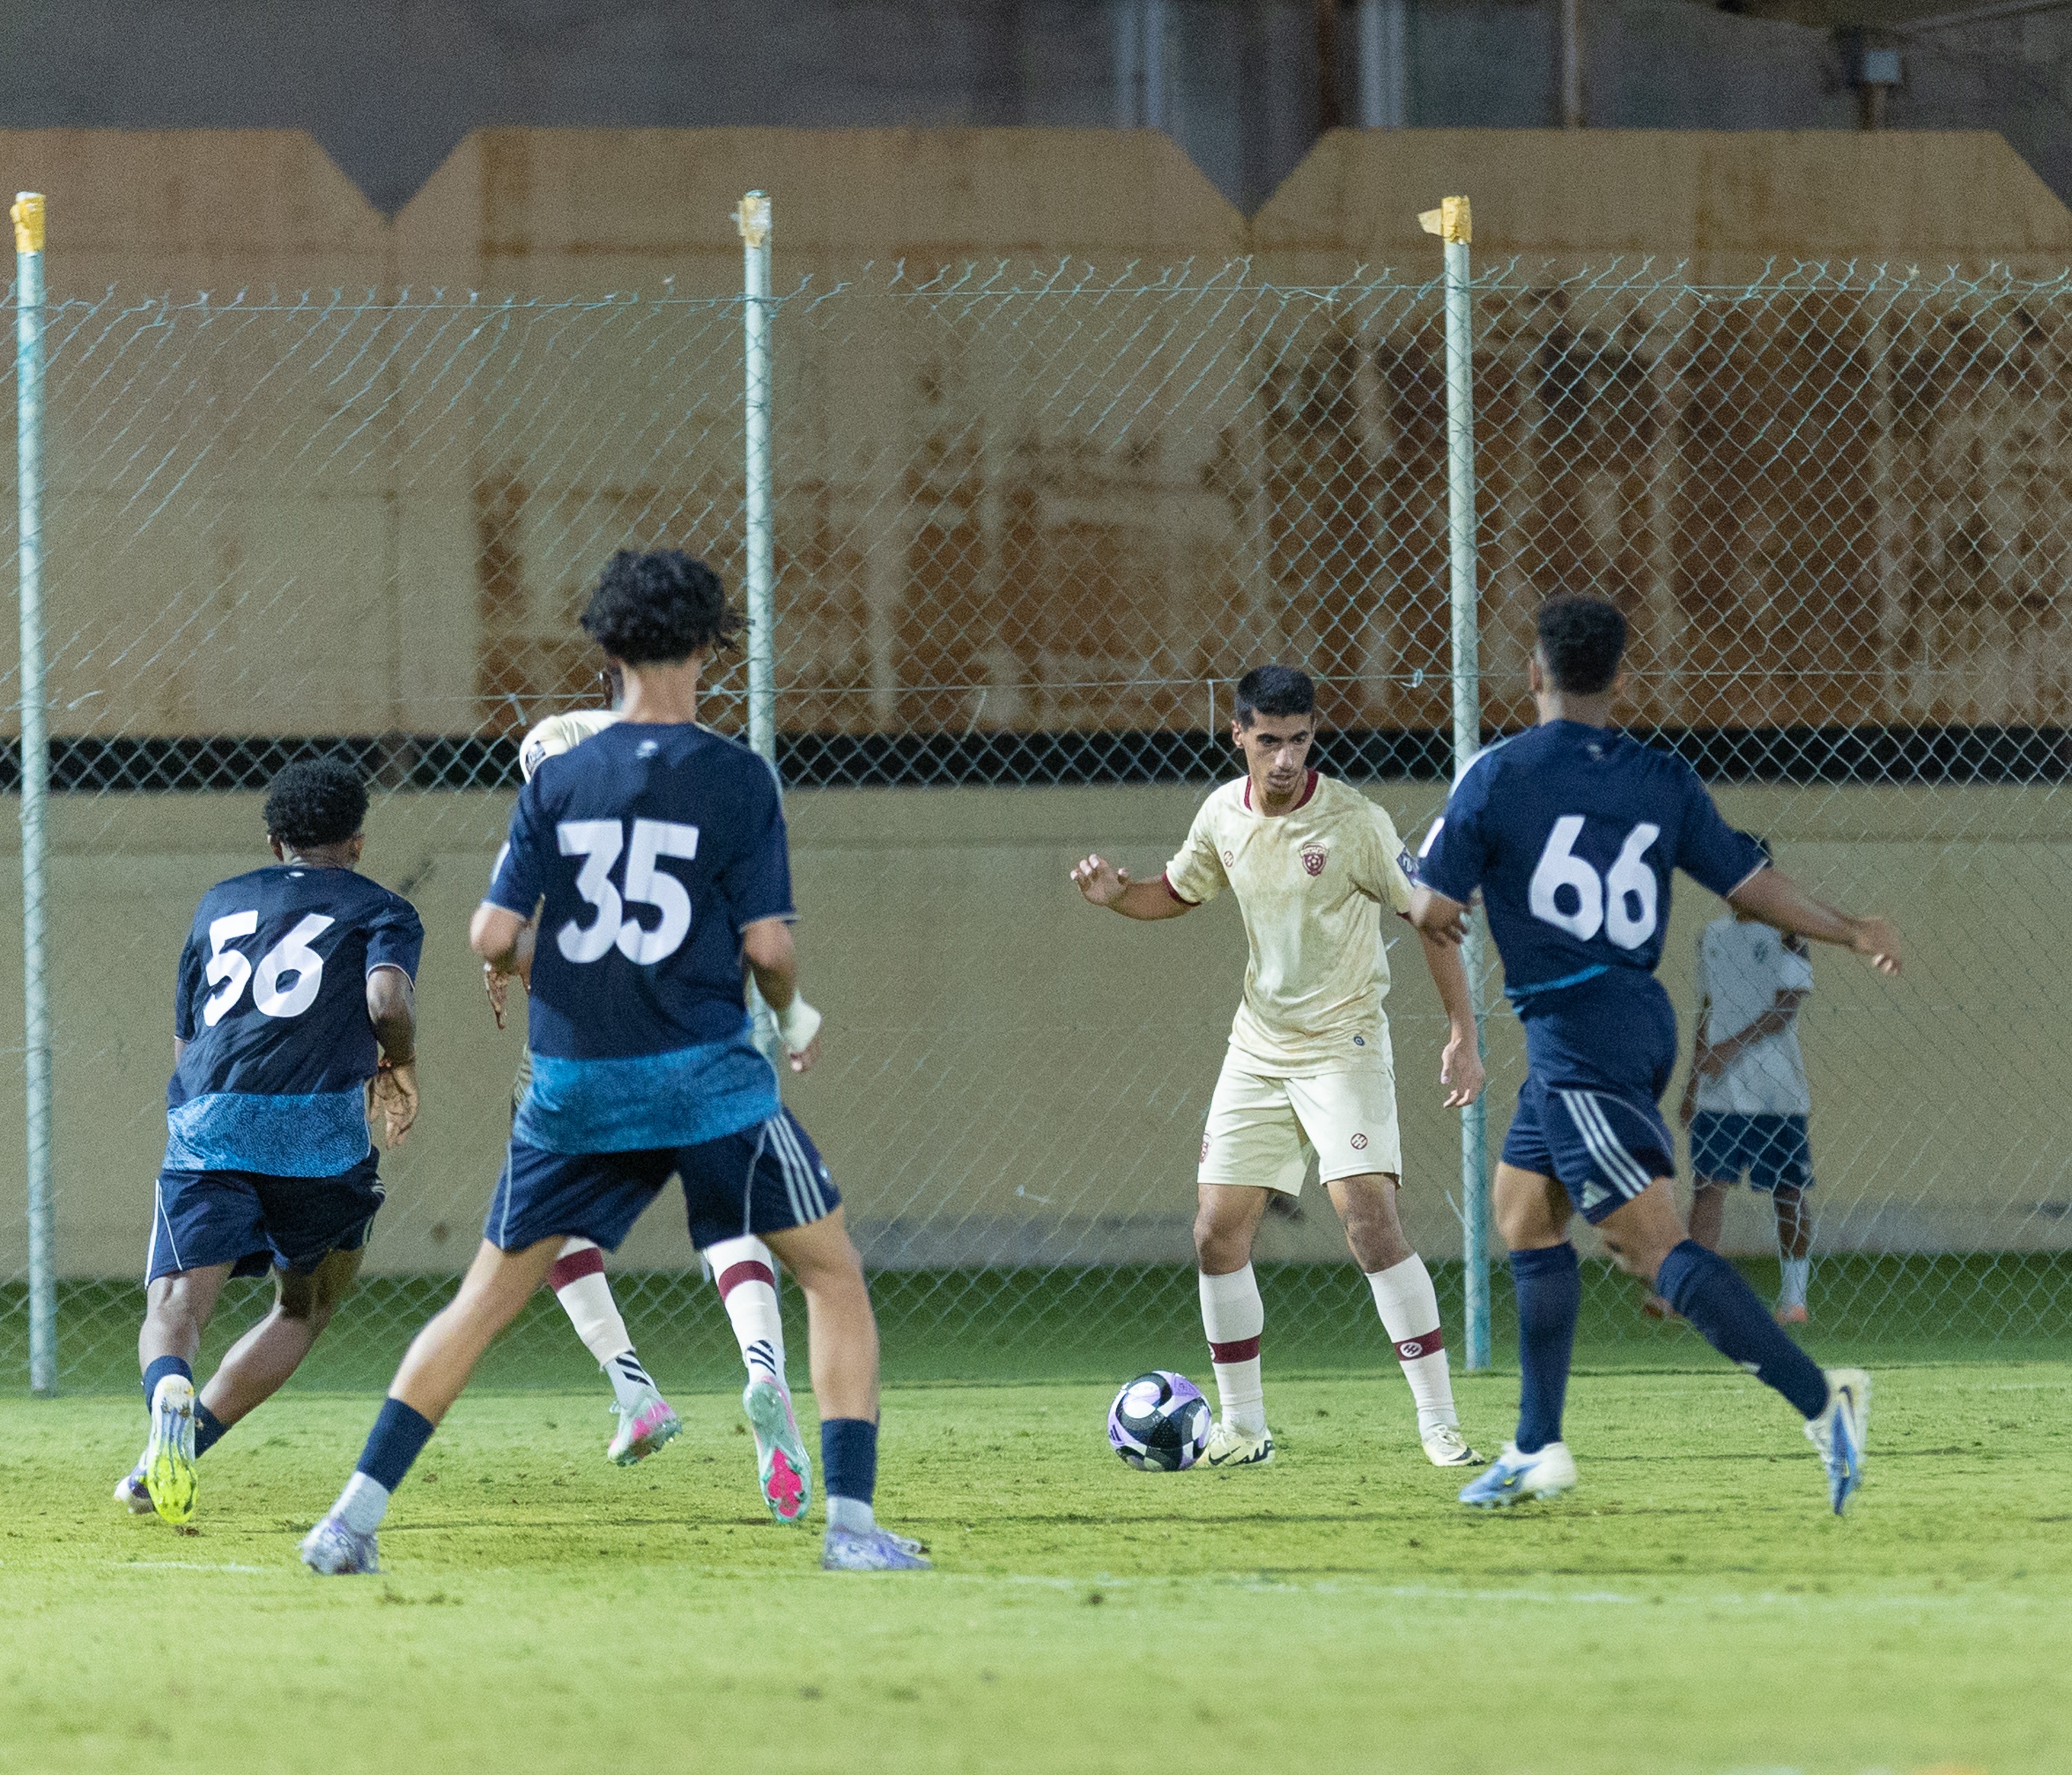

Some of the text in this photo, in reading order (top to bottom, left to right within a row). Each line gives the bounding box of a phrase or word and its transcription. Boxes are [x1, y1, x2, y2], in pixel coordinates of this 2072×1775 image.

[557, 819, 699, 966] 35
[1529, 816, 1660, 950] 66
[203, 910, 336, 1026] 56
